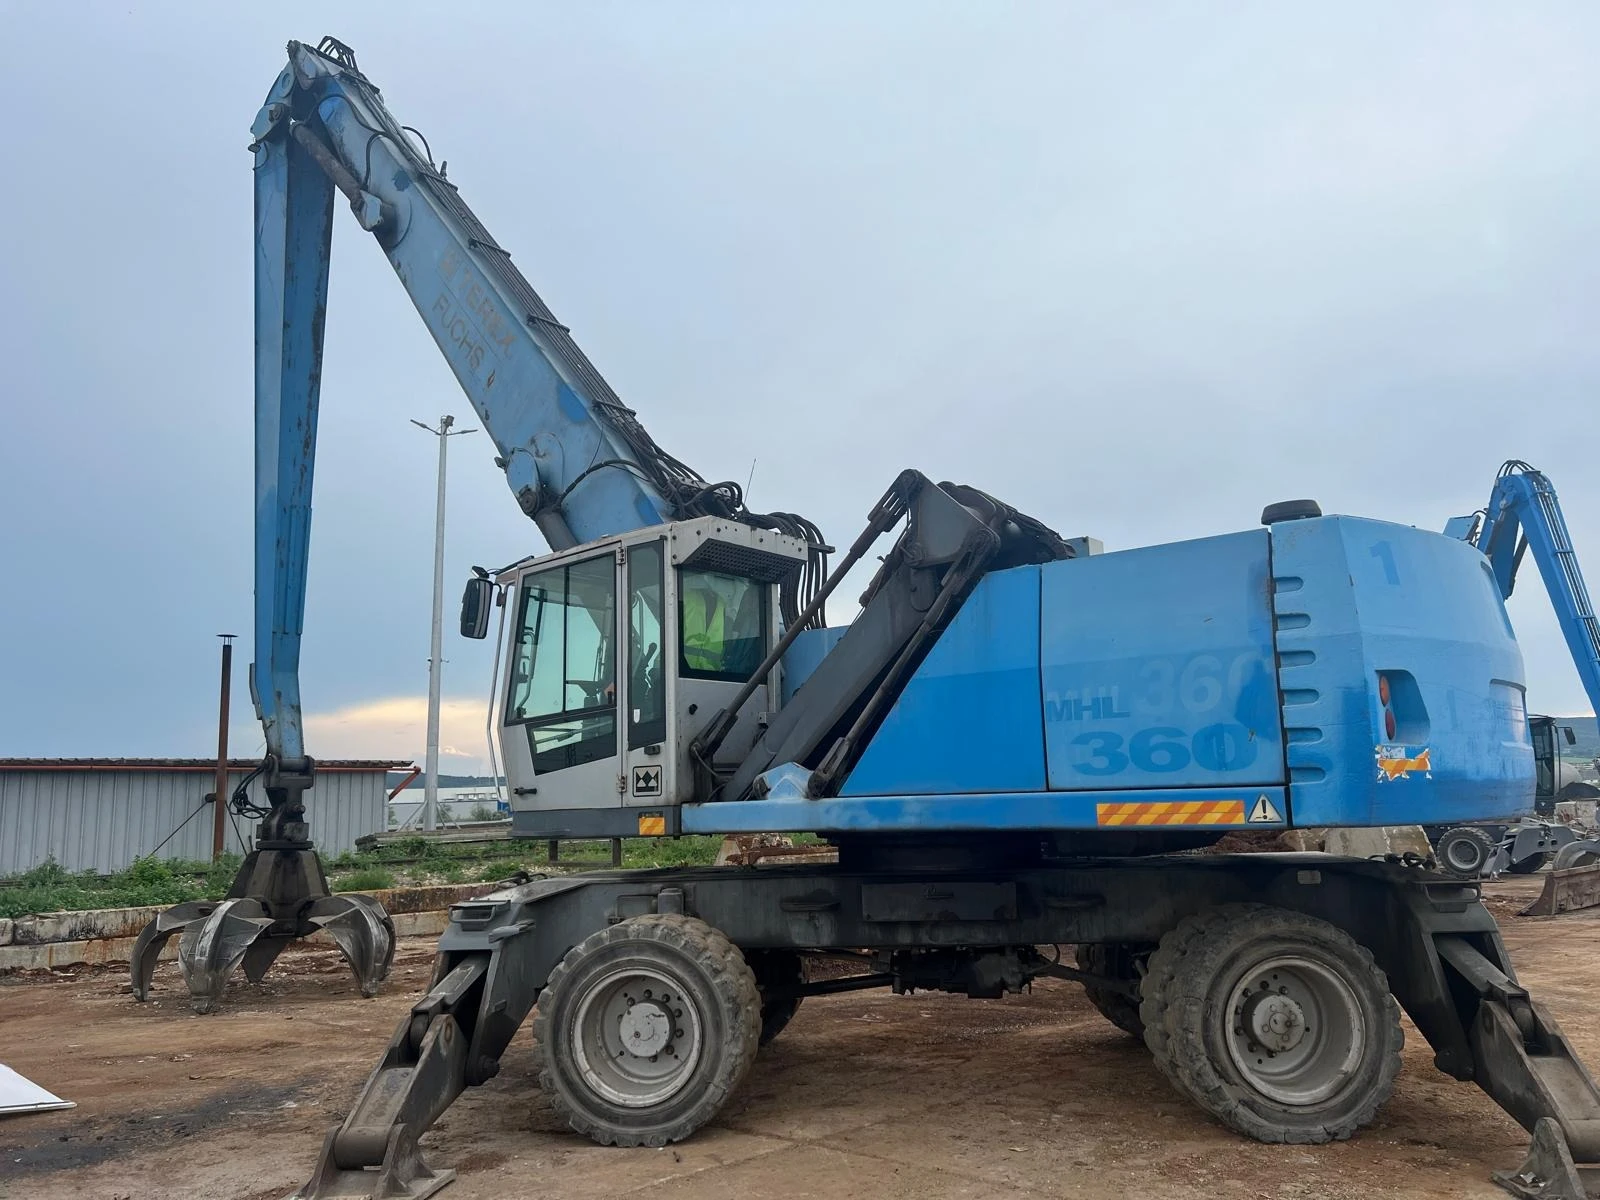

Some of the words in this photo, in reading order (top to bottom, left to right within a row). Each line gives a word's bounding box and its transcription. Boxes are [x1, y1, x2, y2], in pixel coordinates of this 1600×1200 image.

[432, 293, 485, 370] FUCHS
[1368, 540, 1401, 586] 1
[1046, 696, 1131, 722] MHL
[1070, 723, 1257, 776] 360
